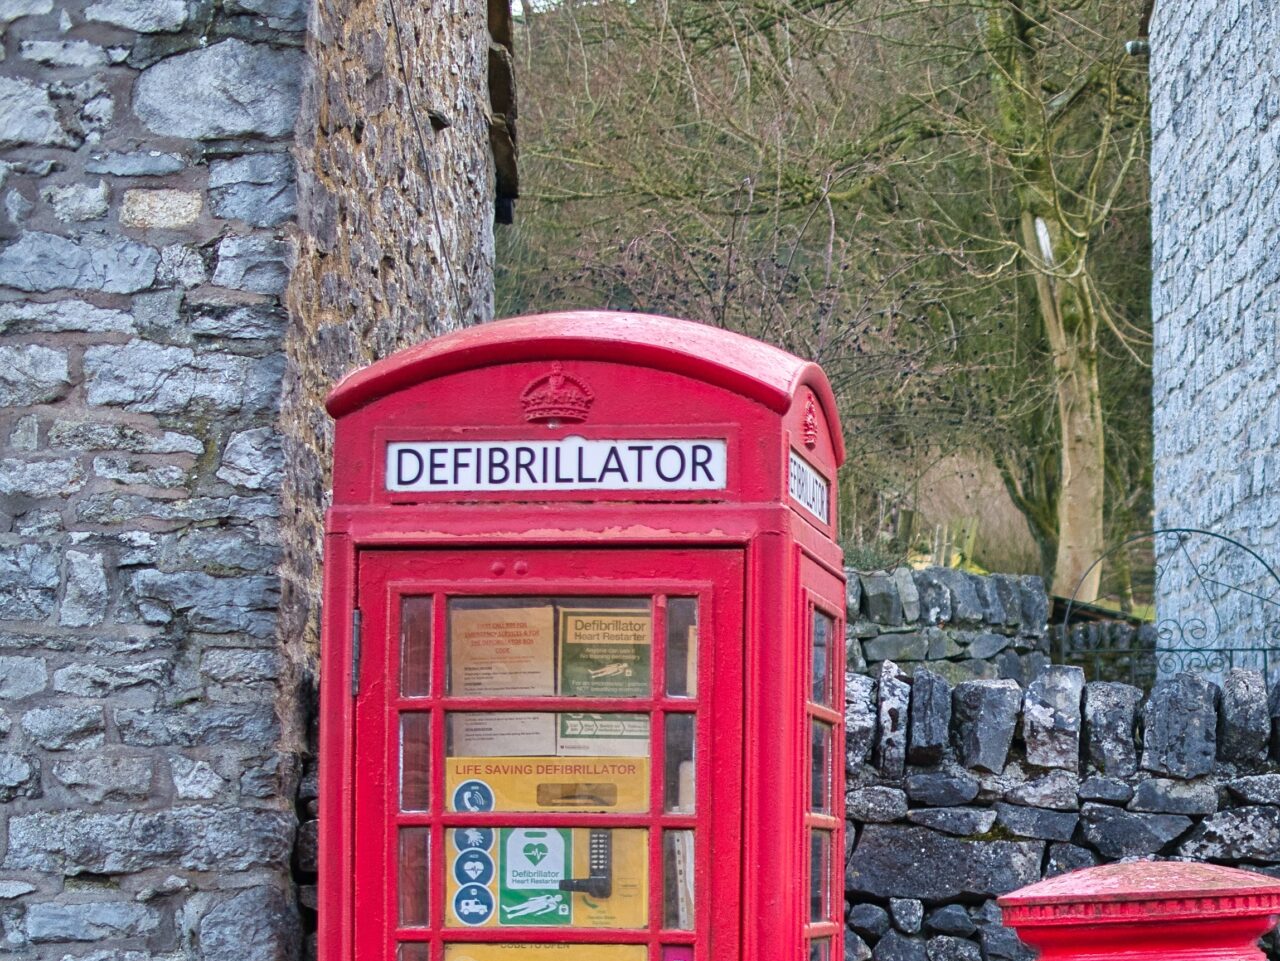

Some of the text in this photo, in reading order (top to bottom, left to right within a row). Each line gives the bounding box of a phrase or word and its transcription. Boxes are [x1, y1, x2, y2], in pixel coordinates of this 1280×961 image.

[397, 445, 715, 486] DEFIBRILLATOR
[789, 456, 828, 519] EFIBRILLATOR
[574, 619, 647, 632] Defibrillator
[574, 632, 647, 641] Heart Restarter
[455, 764, 636, 775] LIFE SAVING DEFIBRILLATOR
[511, 869, 560, 879] Defibrillator
